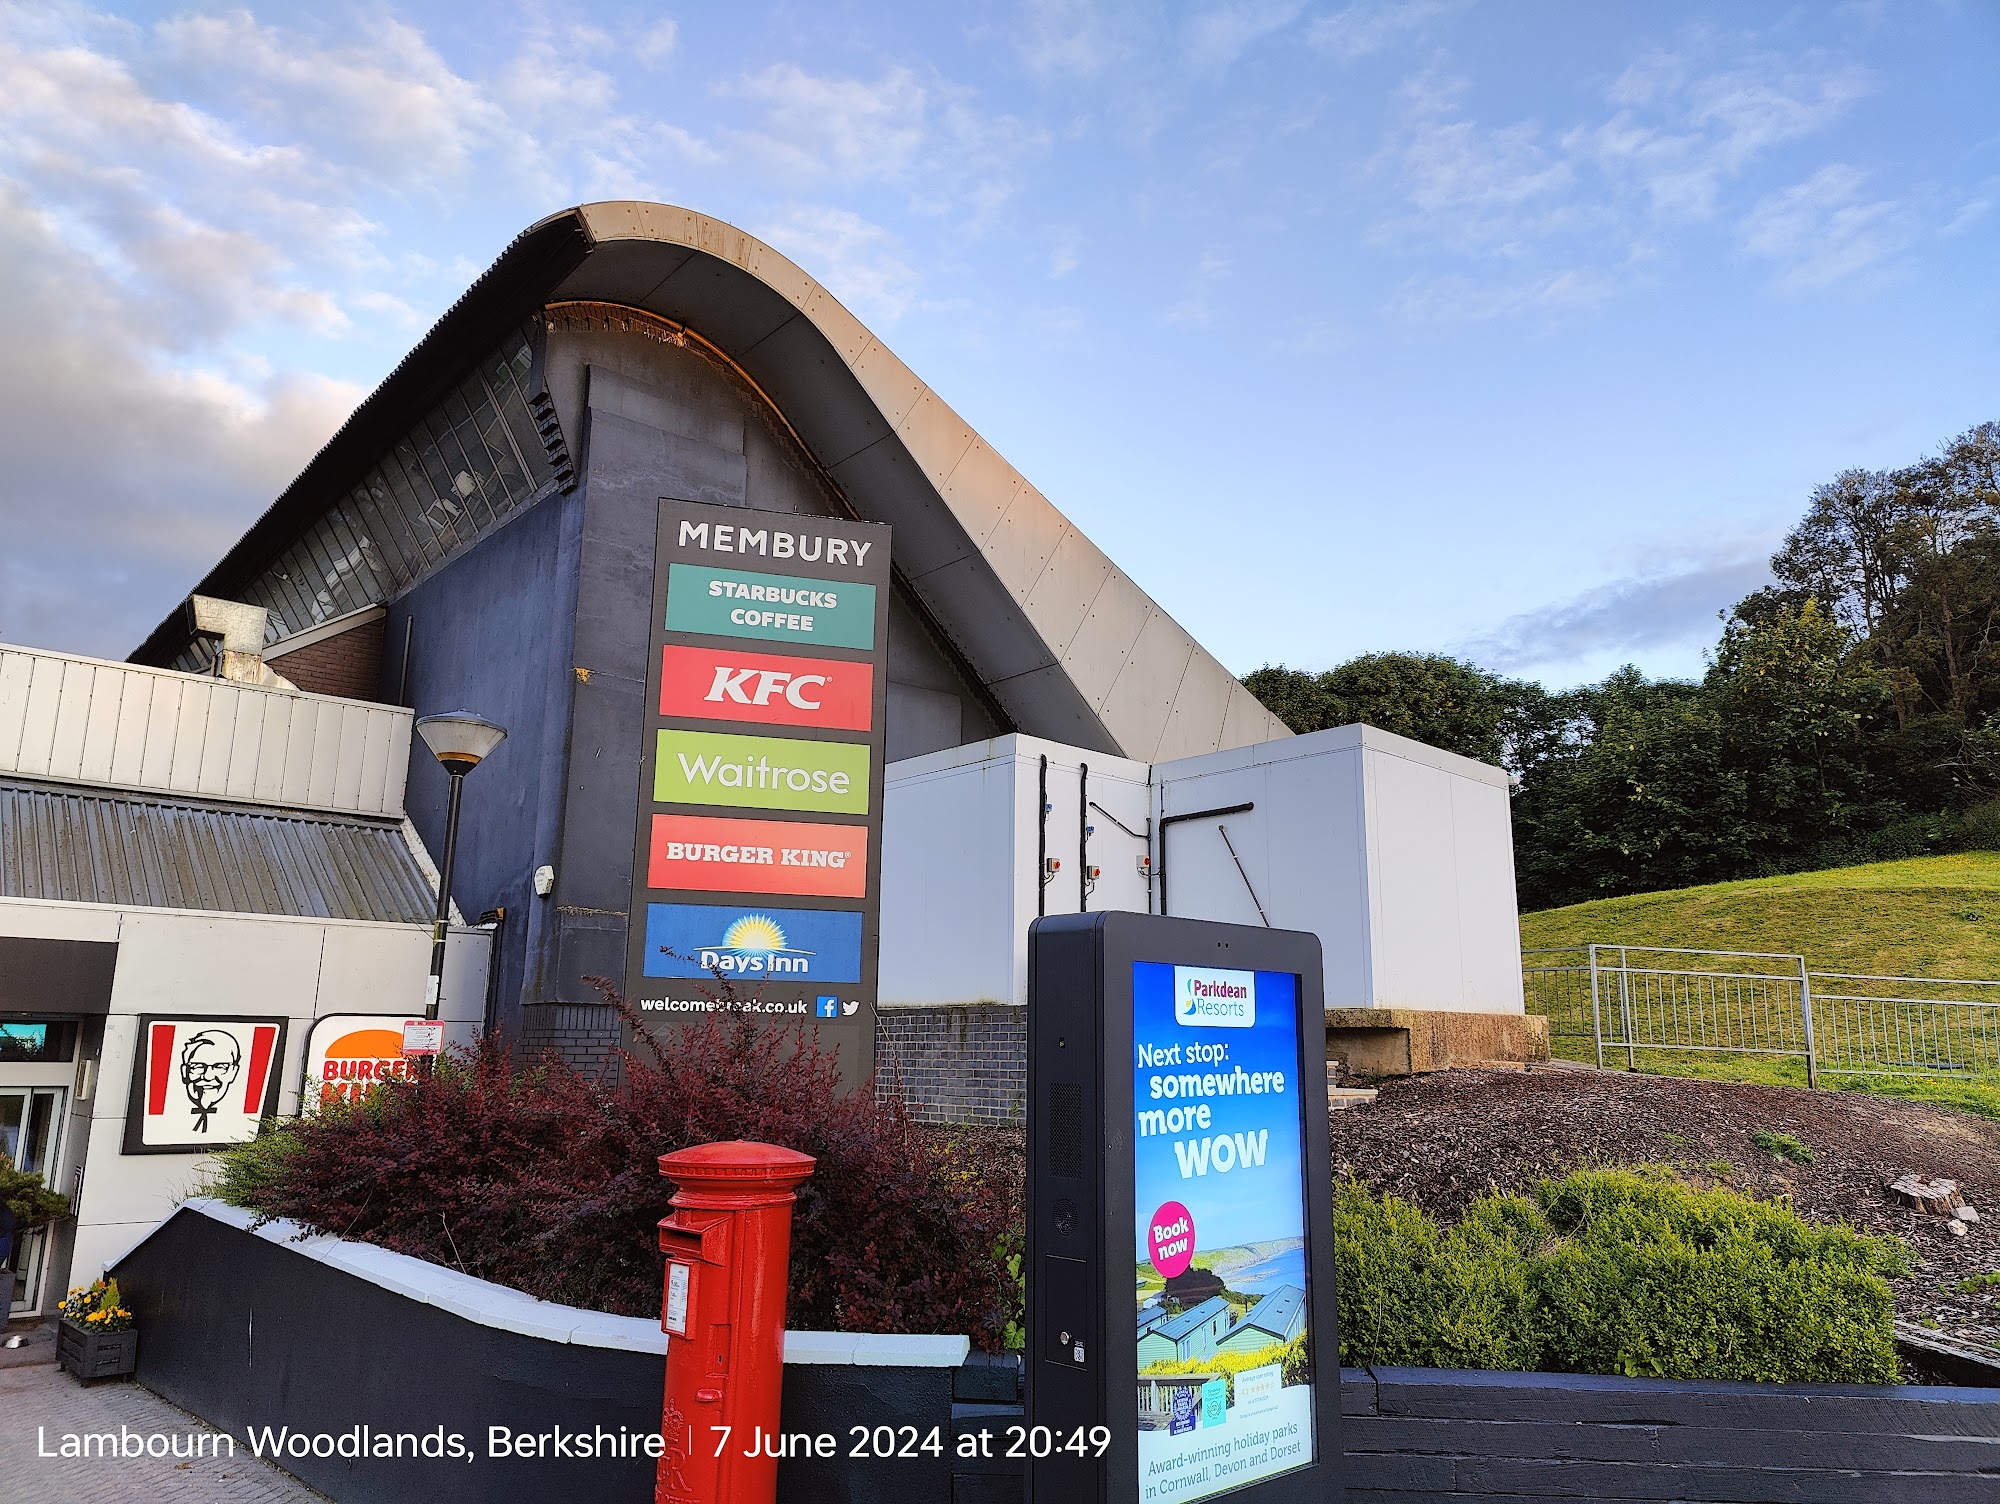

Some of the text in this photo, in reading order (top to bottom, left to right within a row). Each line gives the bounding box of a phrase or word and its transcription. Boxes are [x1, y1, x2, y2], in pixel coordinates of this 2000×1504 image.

[678, 520, 872, 567] MEMBURY
[708, 580, 838, 609] STARBUCKS
[730, 608, 814, 632] COFFEE
[703, 666, 827, 710] KFC
[677, 752, 850, 794] Waitrose
[666, 841, 848, 869] BURGER KING
[701, 950, 808, 973] Days Inn
[1193, 979, 1247, 999] Parkdean
[1197, 997, 1245, 1017] Resorts
[1137, 1041, 1229, 1068] Next stop:
[1150, 1065, 1285, 1099] somewhere
[1138, 1103, 1212, 1137] more
[1174, 1128, 1268, 1179] WOW
[1153, 1216, 1190, 1244] Book
[1157, 1235, 1188, 1262] now
[1148, 1422, 1298, 1477] Award-winning holiday parks
[1145, 1440, 1301, 1500] in Cornwall, Devon and Dorset
